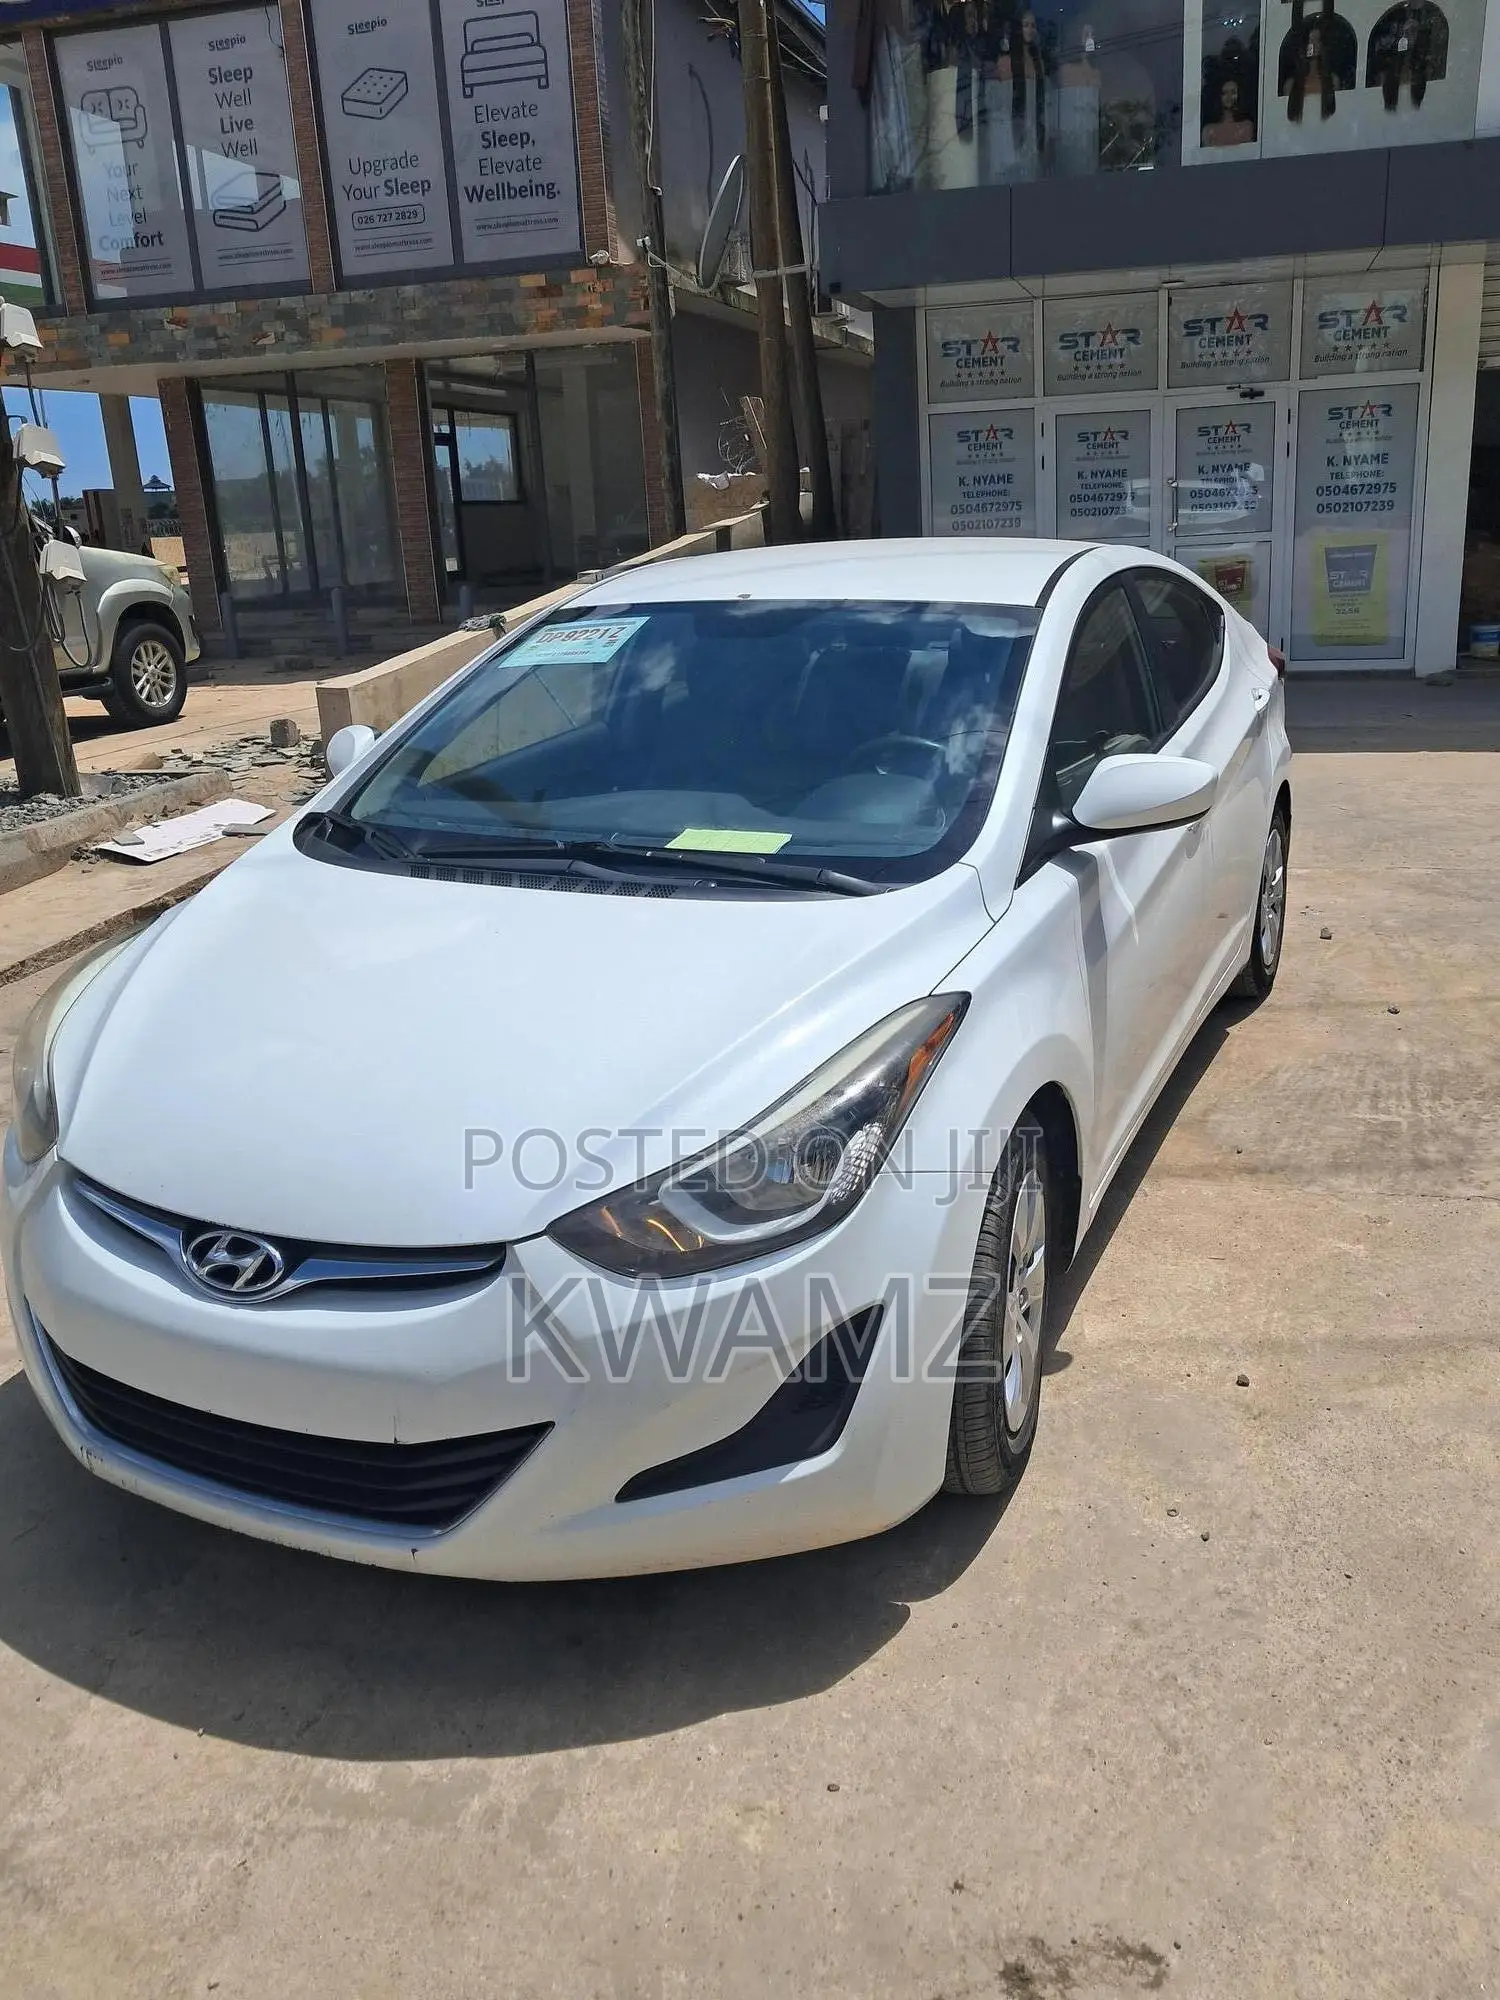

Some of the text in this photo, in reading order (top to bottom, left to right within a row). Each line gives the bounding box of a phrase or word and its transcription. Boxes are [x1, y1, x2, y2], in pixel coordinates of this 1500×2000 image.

[347, 16, 388, 35] Sleepio
[208, 34, 246, 51] Sleepio
[208, 65, 253, 85] Sleep
[215, 88, 252, 109] Well
[474, 100, 538, 124] Elevate
[220, 116, 254, 134] Live
[221, 137, 258, 159] Well
[481, 130, 535, 149] Sleep,
[102, 161, 138, 178] Your
[348, 151, 419, 178] Upgrade
[478, 155, 542, 176] Elevate
[107, 184, 144, 202] Next
[342, 178, 431, 201] Your Sleep
[463, 179, 560, 203] Wellbeing.
[108, 207, 147, 228] Level
[357, 210, 418, 225] 026 727 2829
[100, 230, 164, 251] Comfort
[1183, 305, 1269, 337] STAR
[1318, 300, 1408, 329] STAR
[1059, 321, 1141, 350] STAR
[1199, 333, 1252, 349] CEMENT
[1333, 326, 1391, 341] CEMENT
[941, 330, 1020, 357] STAR
[956, 355, 1005, 368] CEMENT
[1074, 348, 1125, 361] CEMENT
[1314, 352, 1347, 362] Building
[1181, 360, 1211, 369] Building
[1328, 400, 1393, 420] STAR
[957, 423, 1014, 443] STAR
[1197, 419, 1252, 437] STAR
[1339, 419, 1380, 430] CEMENT
[1077, 426, 1129, 442] STAR
[1207, 434, 1241, 444] CEMENT
[968, 441, 1004, 452] CEMENT
[1086, 442, 1120, 450] CEMENT
[1198, 462, 1251, 475] K. NYAME
[1326, 453, 1389, 467] K. NYAME
[958, 473, 1014, 487] K. NYAME
[1077, 469, 1128, 480] K. NYAME
[1069, 492, 1136, 503] 0504672975
[1315, 482, 1397, 497] 0504672975
[950, 501, 1022, 515] 0504672975
[1070, 506, 1132, 517] 050210723
[1316, 500, 1395, 513] 0502107239
[951, 518, 1021, 531] 0502107239
